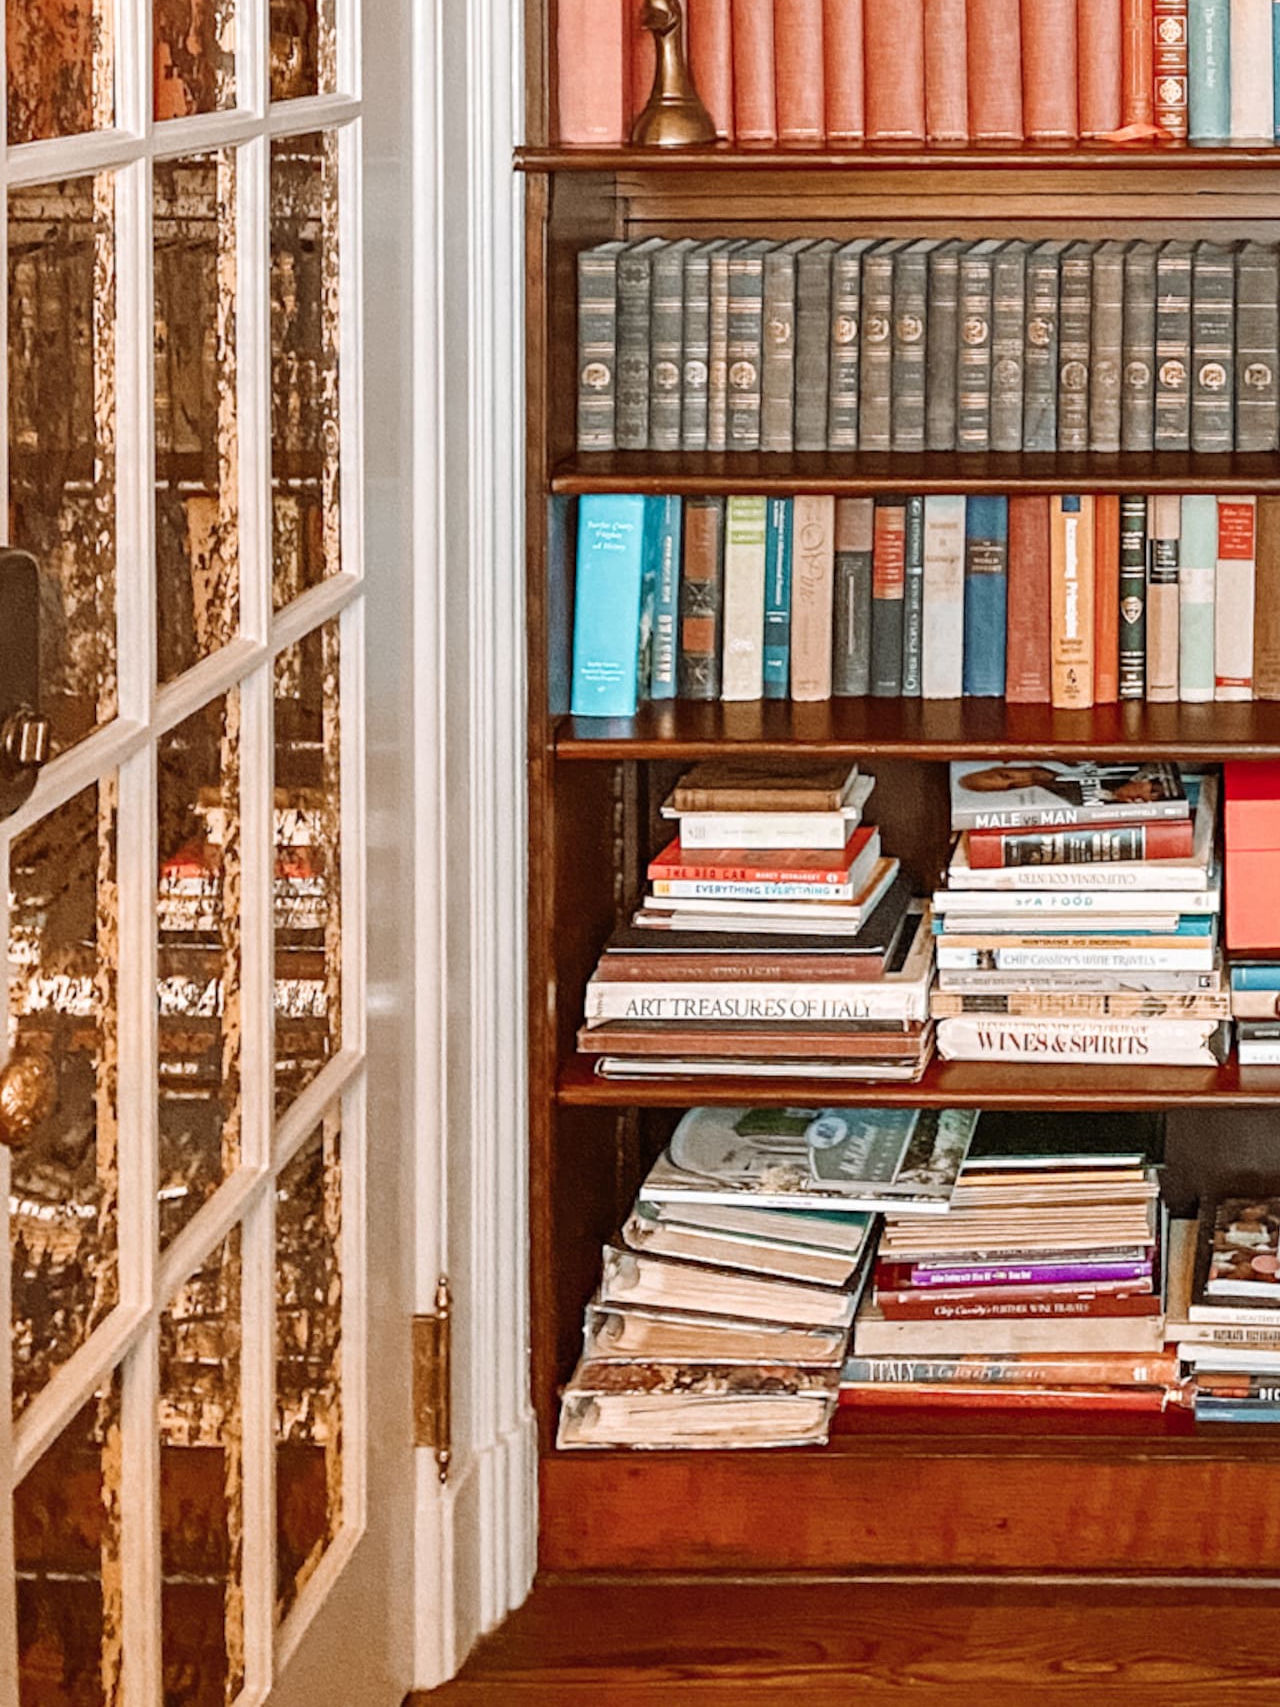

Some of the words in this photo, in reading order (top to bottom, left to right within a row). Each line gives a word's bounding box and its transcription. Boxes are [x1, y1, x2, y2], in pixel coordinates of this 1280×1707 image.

[1205, 6, 1215, 23] The
[1205, 27, 1213, 53] wines
[1205, 56, 1214, 65] of
[1204, 68, 1215, 88] Italy
[976, 812, 1020, 829] MALE
[1040, 810, 1078, 825] MAN
[666, 868, 689, 878] THE
[695, 869, 716, 879] RED
[722, 870, 748, 881] CAR
[1018, 874, 1070, 885] COUNTRY
[1074, 874, 1136, 885] CALIFORNIA
[696, 885, 761, 895] EVERYTHING
[765, 885, 830, 896] EVERYTHING
[1016, 897, 1043, 906] SPA
[1051, 896, 1094, 906] FOOD
[1003, 954, 1029, 965] CHIP
[1030, 954, 1080, 966] CASSIDY'S
[1082, 955, 1110, 967] WINE
[1112, 955, 1156, 967] TRAVELS
[626, 998, 663, 1016] ART
[669, 998, 787, 1018] TREASURES
[791, 999, 816, 1018] OF
[821, 998, 873, 1019] ITALY
[978, 1032, 1048, 1052] WINES
[1051, 1034, 1067, 1052] &
[1069, 1033, 1150, 1055] SPIRITS
[934, 1304, 953, 1317] Chip
[955, 1304, 991, 1317] Cassidy's
[1028, 1303, 1052, 1314] WINE
[868, 1363, 916, 1383] ITALY
[939, 1366, 992, 1380] Culinary
